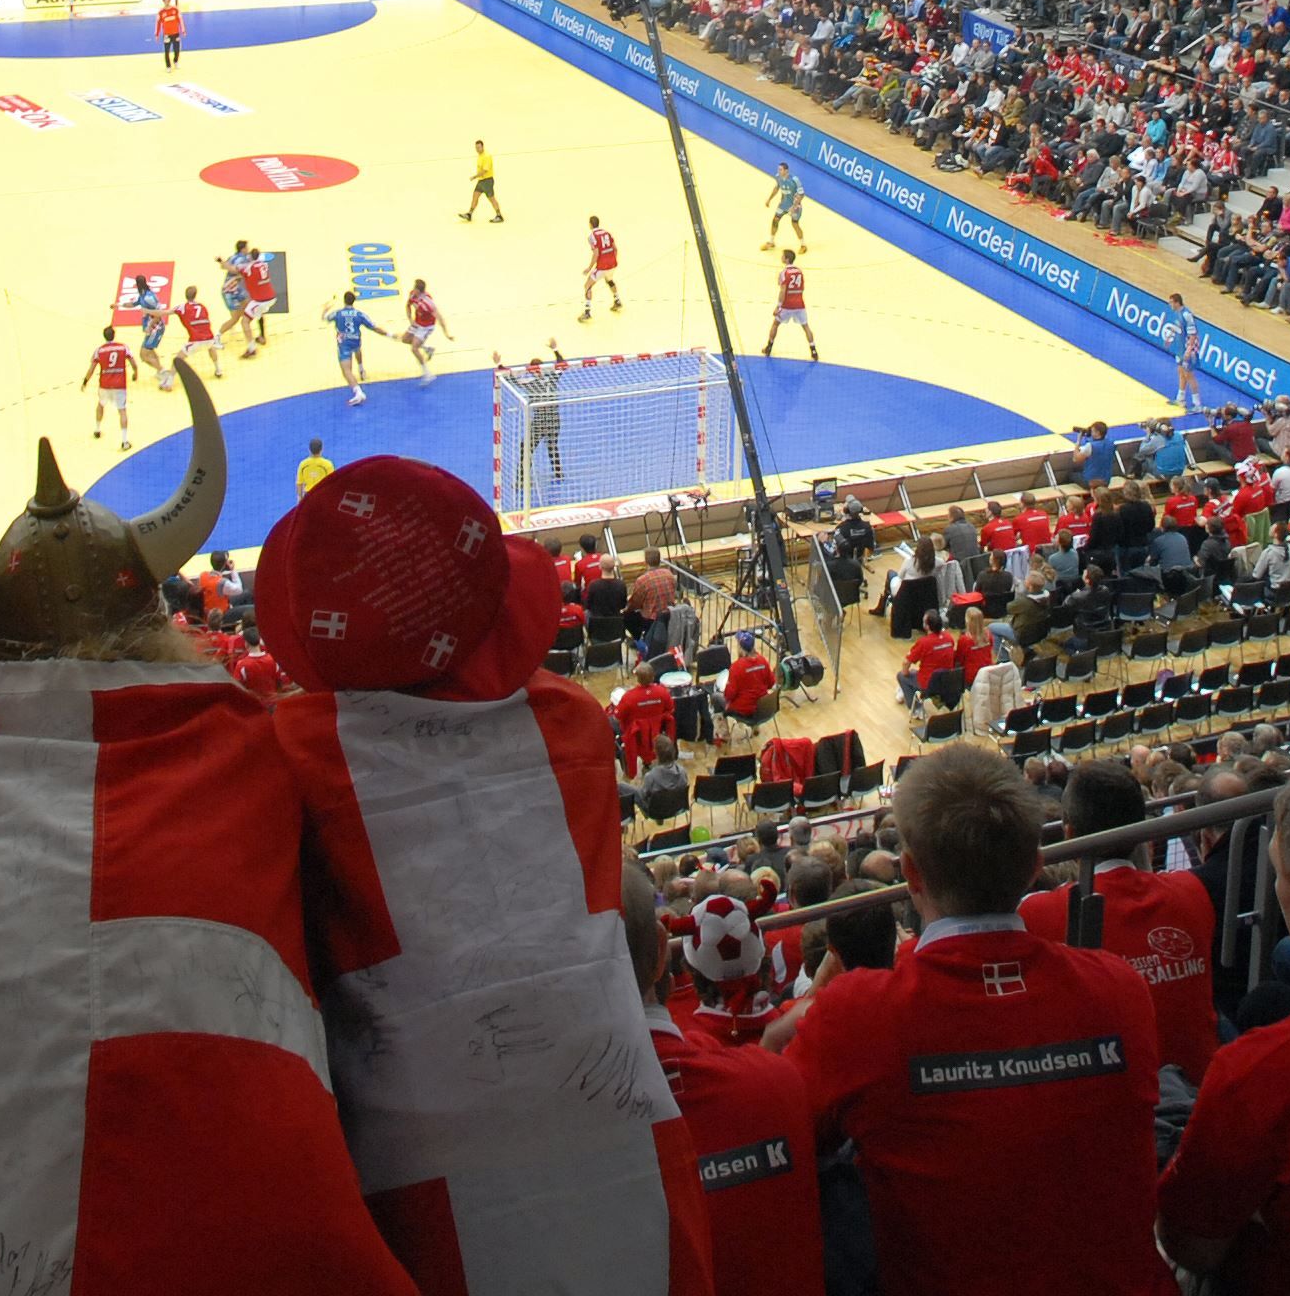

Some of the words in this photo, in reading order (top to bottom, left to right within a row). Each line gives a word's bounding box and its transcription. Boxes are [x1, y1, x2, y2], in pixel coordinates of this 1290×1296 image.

[551, 9, 585, 35] Nordea
[585, 26, 614, 52] Invest
[625, 44, 656, 75] Norde
[667, 64, 699, 97] Invest
[713, 88, 758, 128] Nordea
[761, 111, 802, 149] Invest
[818, 141, 873, 187] Nordea
[876, 170, 926, 214] Invest
[946, 206, 1015, 261] Nordea
[1019, 242, 1081, 294] Invest
[788, 274, 802, 289] 24
[193, 306, 202, 319] 7
[109, 352, 118, 368] 9
[1106, 287, 1176, 343] Norde
[1197, 333, 1278, 395] Invest
[137, 520, 157, 535] EM
[161, 488, 195, 525] NORGE
[1122, 953, 1160, 967] assen
[921, 1061, 993, 1084] Lauritz
[1000, 1051, 1092, 1076] Knudsen
